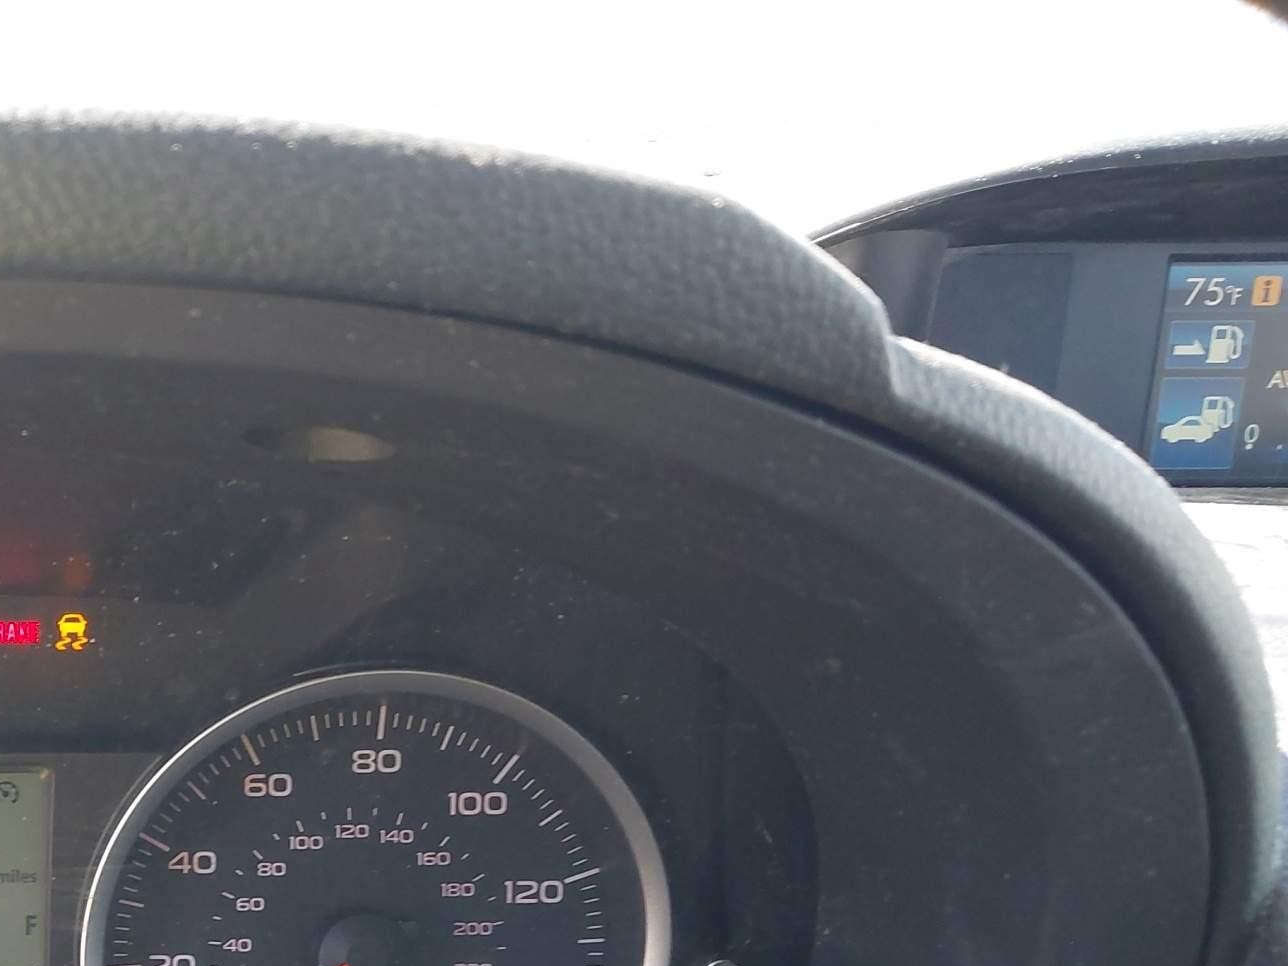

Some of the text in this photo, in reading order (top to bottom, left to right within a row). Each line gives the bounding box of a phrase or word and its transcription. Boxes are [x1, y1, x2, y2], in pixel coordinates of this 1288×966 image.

[351, 750, 401, 773] 80
[244, 774, 293, 797] 60
[447, 791, 508, 816] 100
[334, 824, 370, 839] 120
[380, 829, 414, 844] 140
[289, 836, 323, 850] 100
[168, 851, 217, 874] 40
[416, 852, 451, 866] 160
[257, 862, 287, 876] 80
[441, 883, 476, 897] 180
[504, 880, 564, 904] 120
[236, 898, 265, 911] 60
[25, 915, 38, 936] F
[453, 922, 494, 936] 200
[223, 938, 252, 952] 40
